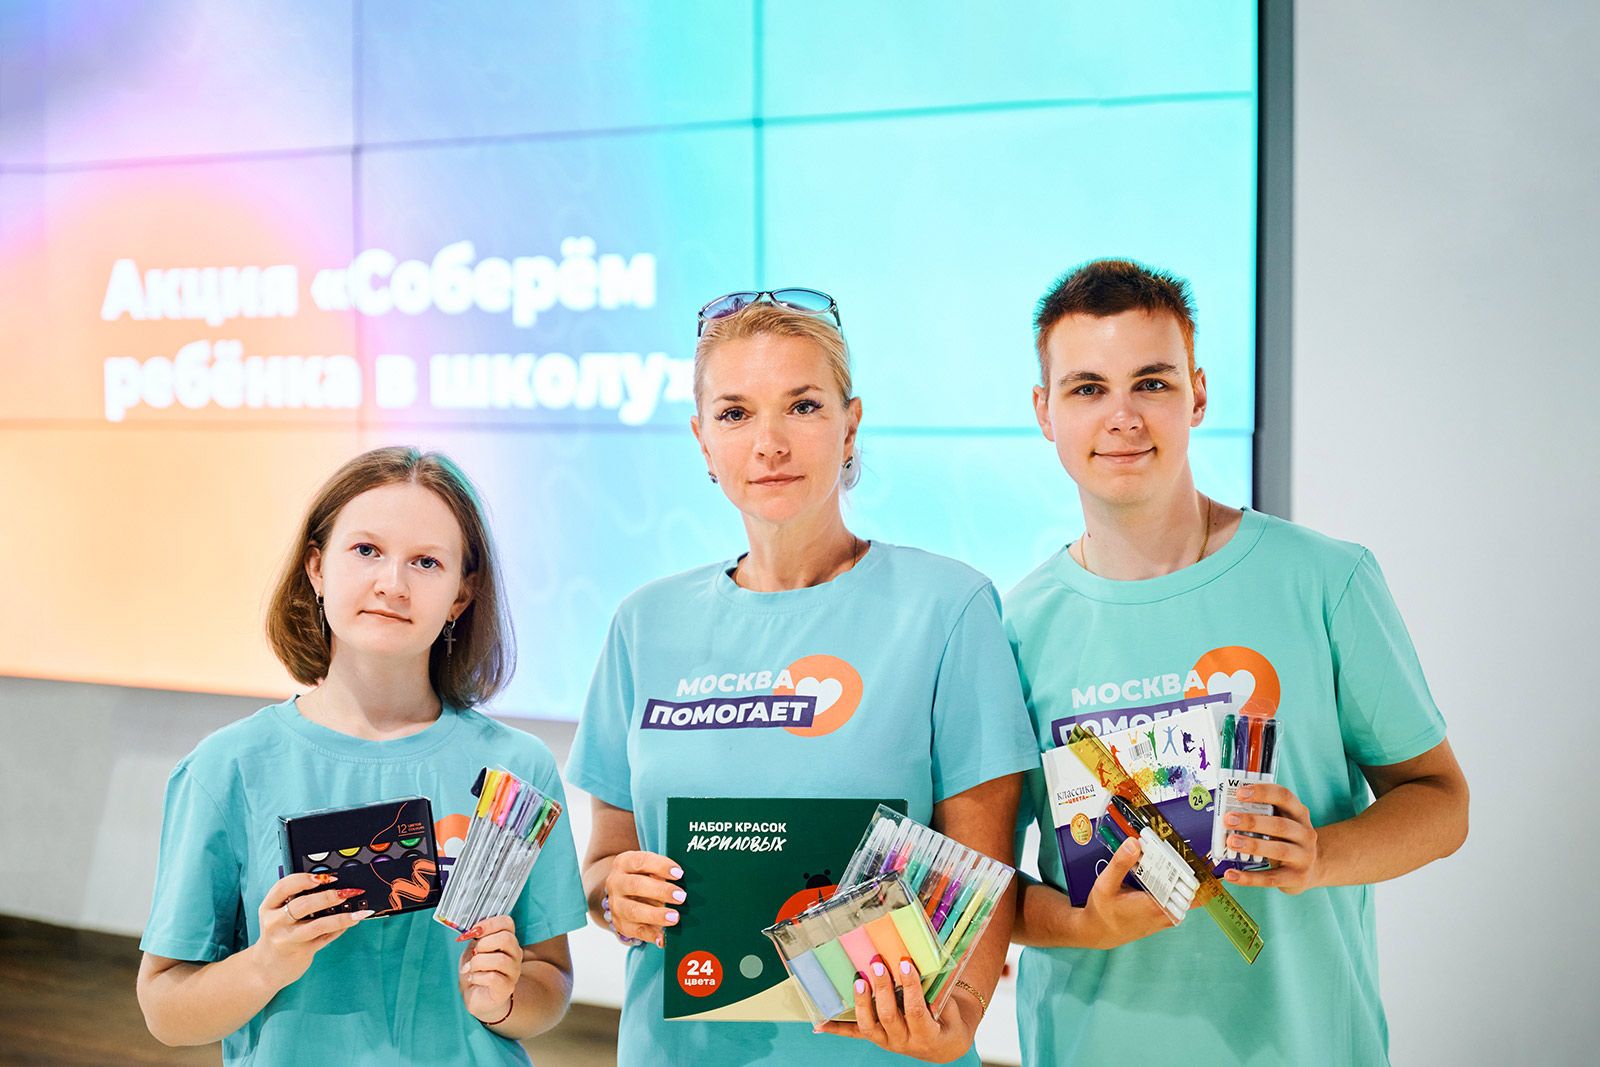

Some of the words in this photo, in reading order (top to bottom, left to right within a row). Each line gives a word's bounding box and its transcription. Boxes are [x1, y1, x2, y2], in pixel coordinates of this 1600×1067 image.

[101, 257, 298, 326] Акция
[310, 236, 656, 328] «Соберём
[103, 339, 363, 422] ребёнка
[375, 353, 418, 408] в
[676, 669, 795, 697] МОСКВА
[1071, 669, 1206, 709] МОСКВА
[648, 701, 809, 726] ПОМОГАЕТ
[1192, 794, 1204, 806] 24
[397, 823, 408, 834] 12
[689, 821, 733, 832] НАБОР
[735, 822, 787, 833] КРАСОК
[686, 834, 787, 853] АКРИЛОВЫХ
[686, 959, 714, 976] 24
[684, 978, 716, 987] цвета
